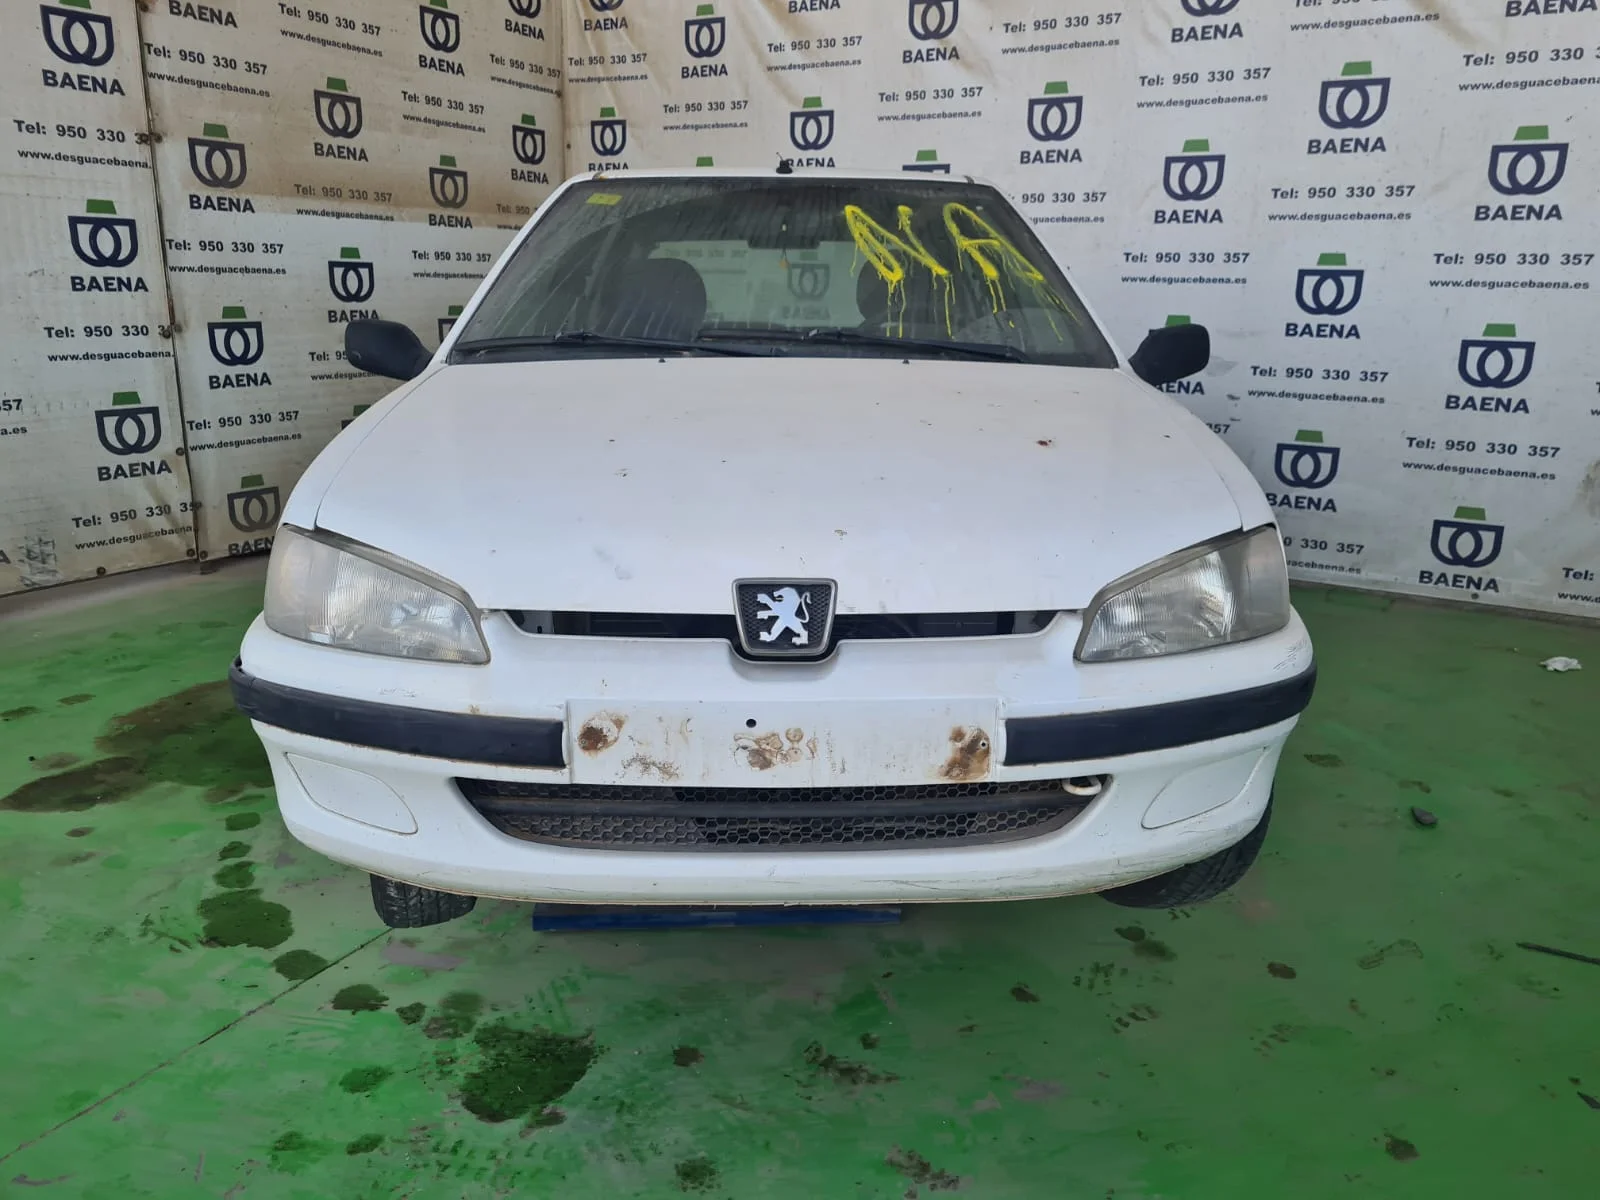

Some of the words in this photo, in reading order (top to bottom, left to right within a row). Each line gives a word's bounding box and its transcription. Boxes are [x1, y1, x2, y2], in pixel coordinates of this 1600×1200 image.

[168, 0, 238, 29] BAENA
[788, 0, 841, 14] BAENA
[1505, 0, 1598, 18] BAENA
[278, 2, 301, 18] Tel:
[307, 9, 329, 25] 950
[335, 16, 356, 31] 330
[361, 22, 381, 37] 357
[584, 16, 629, 32] BAENA
[1002, 21, 1026, 33] Tel:
[1033, 18, 1057, 31] 950
[1064, 15, 1089, 28] 330
[1097, 12, 1122, 26] 357
[1290, 12, 1441, 31] www.desguacebaena.es
[505, 18, 545, 41] BAENA
[1171, 22, 1244, 43] BAENA
[280, 28, 383, 57] www.desguacebaena.es
[767, 42, 785, 53] Tel:
[790, 39, 811, 51] 950
[816, 38, 836, 49] 330
[842, 35, 863, 47] 357
[1001, 39, 1120, 55] www.desguacebaena.es
[146, 43, 171, 59] Tel:
[179, 49, 205, 65] 950
[212, 55, 237, 70] 330
[244, 61, 267, 75] 357
[567, 57, 585, 66] Tel:
[588, 55, 605, 66] 950
[610, 54, 627, 65] 330
[631, 52, 648, 63] 357
[902, 46, 961, 64] BAENA
[1463, 53, 1495, 67] Tel:
[1505, 50, 1539, 64] 950
[1550, 47, 1584, 62] 330
[418, 54, 465, 77] BAENA
[489, 53, 506, 66] Tel:
[509, 58, 525, 71] 950
[528, 63, 544, 75] 330
[547, 67, 561, 79] 357
[681, 63, 728, 79] BAENA
[42, 69, 125, 96] BAENA
[147, 70, 270, 98] www.desguacebaena.es
[1139, 74, 1164, 87] Tel:
[1172, 72, 1199, 85] 950
[1207, 70, 1234, 83] 330
[1243, 67, 1271, 80] 357
[401, 90, 420, 104] Tel:
[424, 95, 442, 107] 950
[447, 99, 464, 111] 330
[468, 103, 485, 115] 357
[878, 92, 899, 103] Tel:
[905, 90, 926, 101] 950
[932, 88, 954, 100] 330
[961, 86, 983, 98] 357
[1136, 94, 1268, 109] www.desguacebaena.es
[663, 104, 680, 114] Tel:
[684, 102, 703, 113] 950
[707, 101, 725, 111] 330
[730, 100, 749, 111] 357
[877, 111, 982, 122] www.desguacebaena.es
[13, 119, 47, 135] Tel:
[56, 124, 87, 139] 950
[96, 128, 126, 143] 330
[313, 142, 369, 163] BAENA
[1307, 136, 1386, 155] BAENA
[17, 150, 152, 169] www.desguacebaena.
[1020, 148, 1083, 165] BAENA
[511, 168, 549, 185] BAENA
[293, 183, 316, 196] Tel:
[321, 186, 343, 199] 950
[348, 189, 368, 201] 330
[373, 191, 392, 203] 357
[1022, 193, 1045, 204] 950
[1052, 192, 1076, 203] 330
[1082, 191, 1107, 203] 357
[1271, 187, 1299, 199] Tel:
[1308, 186, 1337, 199] 950
[1345, 186, 1376, 198] 330
[1385, 185, 1416, 198] 357
[189, 194, 256, 214] BAENA
[1474, 204, 1563, 221] BAENA
[428, 213, 473, 229] BAENA
[1154, 209, 1223, 224] BAENA
[1268, 211, 1412, 223] www.desguacebaena.es
[165, 238, 191, 251] Tel:
[198, 240, 224, 252] 950
[231, 241, 255, 253] 330
[261, 242, 284, 254] 357
[411, 250, 430, 260] Tel:
[434, 251, 451, 261] 950
[455, 252, 472, 262] 330
[476, 253, 492, 263] 357
[1123, 252, 1148, 263] Tel:
[1155, 252, 1181, 263] 950
[1188, 252, 1215, 263] 330
[1223, 252, 1250, 264] 357
[1433, 253, 1464, 265] Tel:
[1474, 253, 1506, 265] 950
[1516, 253, 1550, 265] 330
[1560, 253, 1595, 266] 357
[168, 264, 287, 275] www.desguacebaena.es
[70, 275, 149, 293] BAENA
[1121, 275, 1247, 285] www.desguacebaena.es
[1429, 278, 1589, 290] www.desguacebaena.es
[328, 310, 379, 323] BAENA
[43, 326, 75, 338] Tel:
[83, 325, 113, 338] 950
[121, 324, 149, 337] 330
[1285, 322, 1361, 339] BAENA
[48, 350, 175, 362] www.desguacebaena.
[308, 351, 330, 362] Tel:
[208, 372, 272, 390] BAENA
[1250, 365, 1277, 377] Tel:
[1286, 367, 1313, 379] 950
[1322, 369, 1350, 381] 330
[1359, 370, 1389, 383] 357
[1445, 394, 1530, 414] BAENA
[186, 419, 211, 431] Tel:
[218, 416, 242, 428] 950
[249, 413, 272, 425] 330
[278, 410, 299, 422] 357
[189, 433, 302, 452] www.desguacebaena.es
[1406, 437, 1436, 449] Tel:
[1445, 439, 1476, 452] 950
[1486, 442, 1518, 455] 330
[1527, 445, 1561, 458] 357
[97, 459, 173, 482] BAENA
[1402, 462, 1556, 480] www.desguacebaena.es
[1265, 492, 1337, 513] BAENA
[71, 515, 102, 528] Tel:
[110, 509, 137, 523] 950
[145, 503, 172, 519] 330
[228, 537, 274, 556] BAEN
[1300, 538, 1328, 551] 330
[1336, 542, 1365, 555] 357
[1418, 570, 1499, 593] BAENA
[1562, 567, 1594, 581] Tel:
